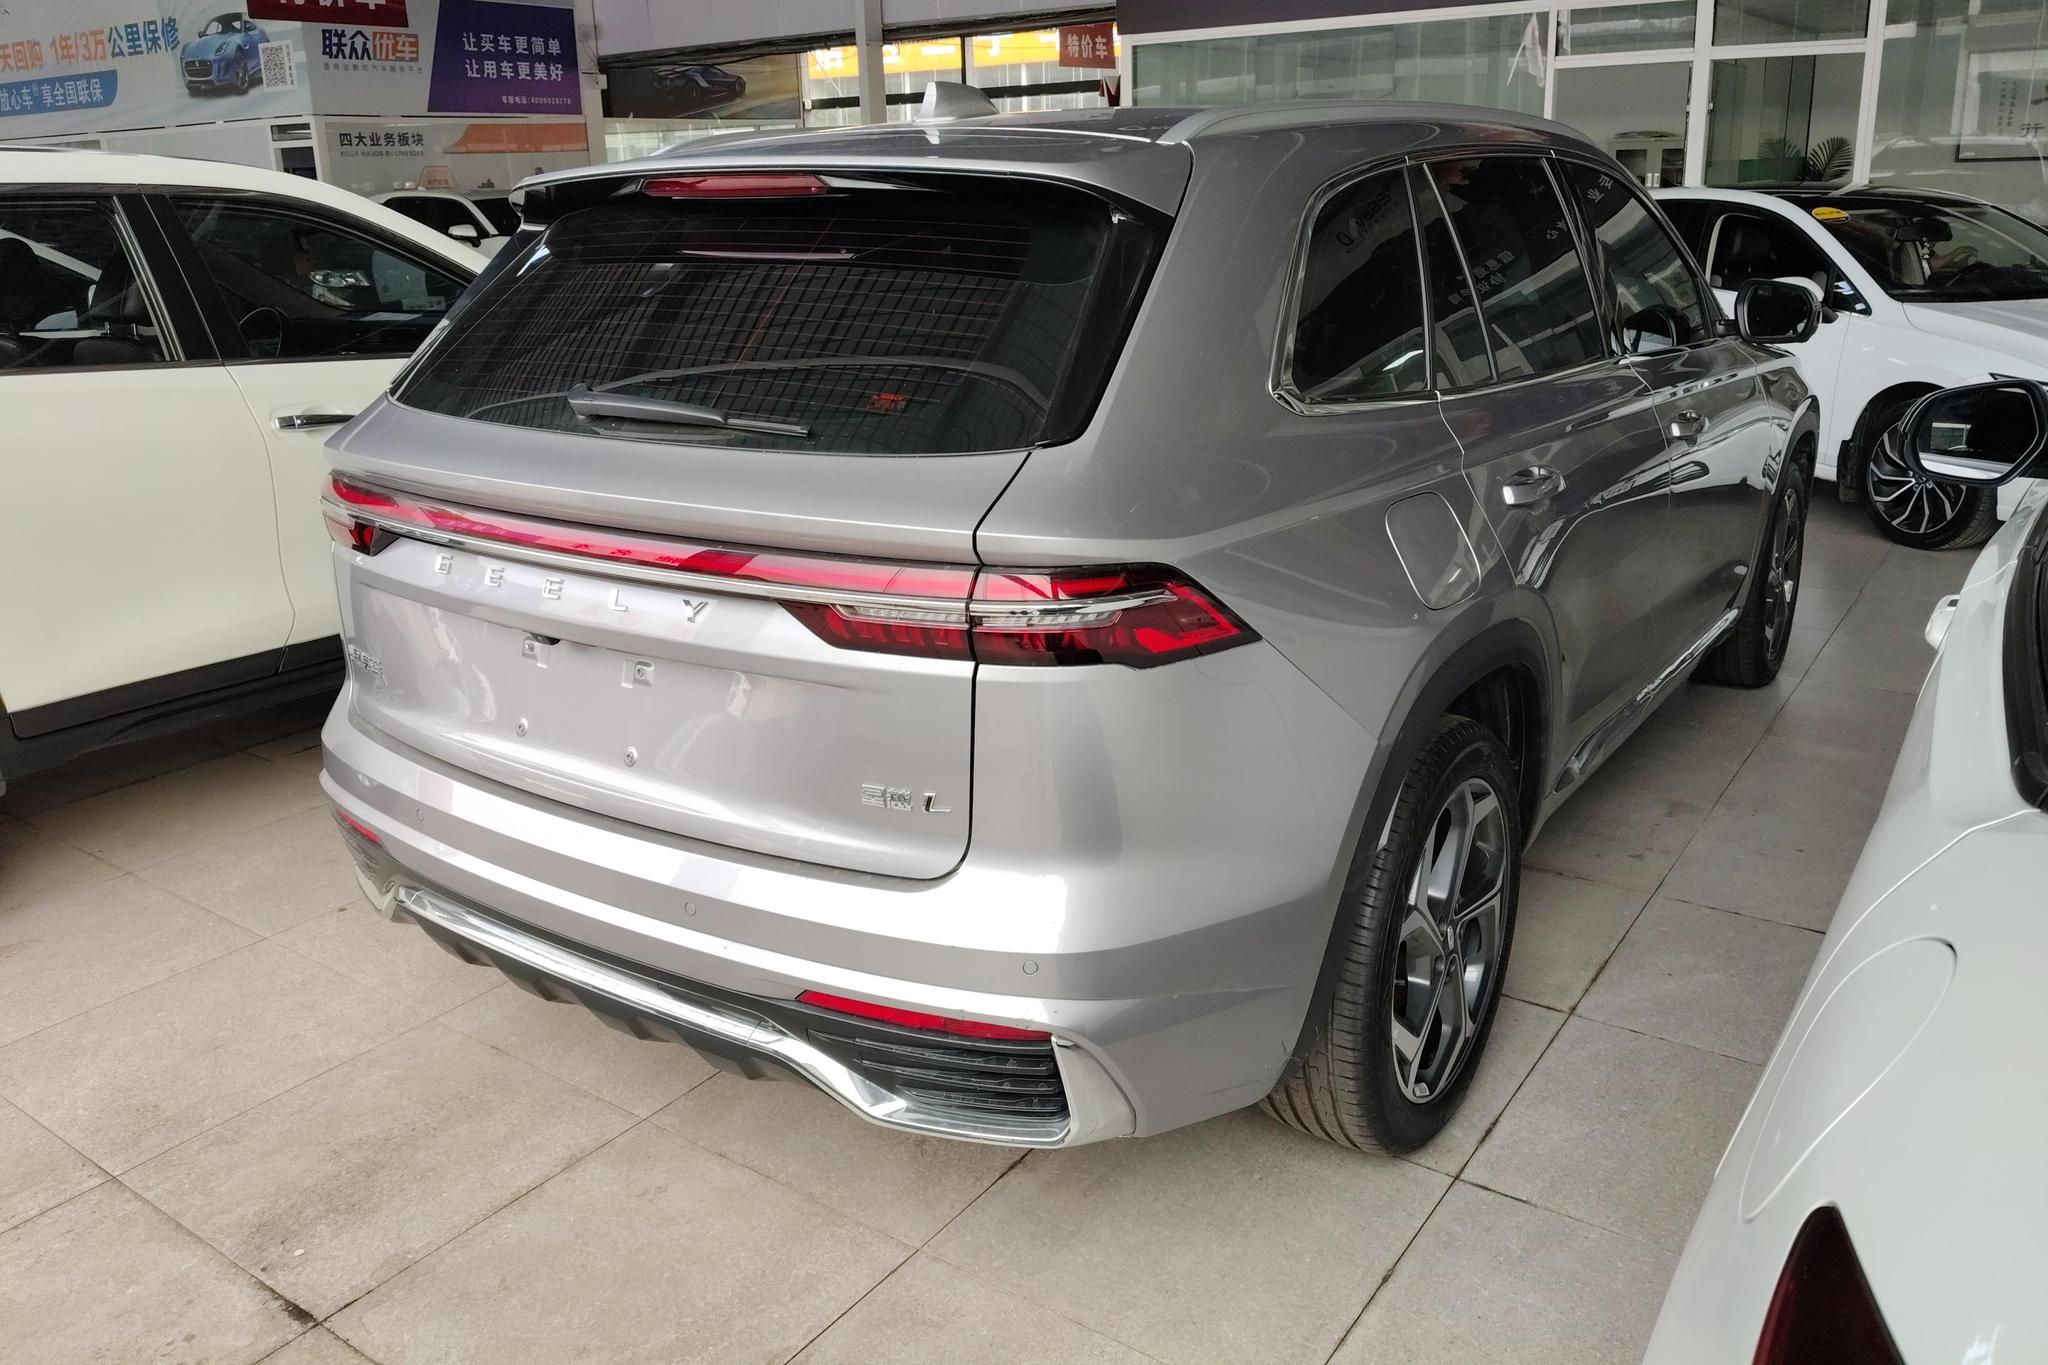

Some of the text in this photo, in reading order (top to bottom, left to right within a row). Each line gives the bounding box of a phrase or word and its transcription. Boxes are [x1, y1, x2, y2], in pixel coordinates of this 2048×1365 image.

[321, 28, 418, 61] 联众优车
[462, 32, 562, 56] 让买车更简单
[1067, 33, 1108, 60] 特价车
[465, 59, 563, 82] 让用车更美好
[0, 86, 34, 112] 放心车
[41, 78, 104, 107] 享全国联保
[339, 132, 425, 148] 四大业务板块
[340, 150, 358, 158] FOUR
[360, 150, 384, 158] MAJOR
[434, 552, 709, 624] GEELY
[922, 792, 953, 813] L
